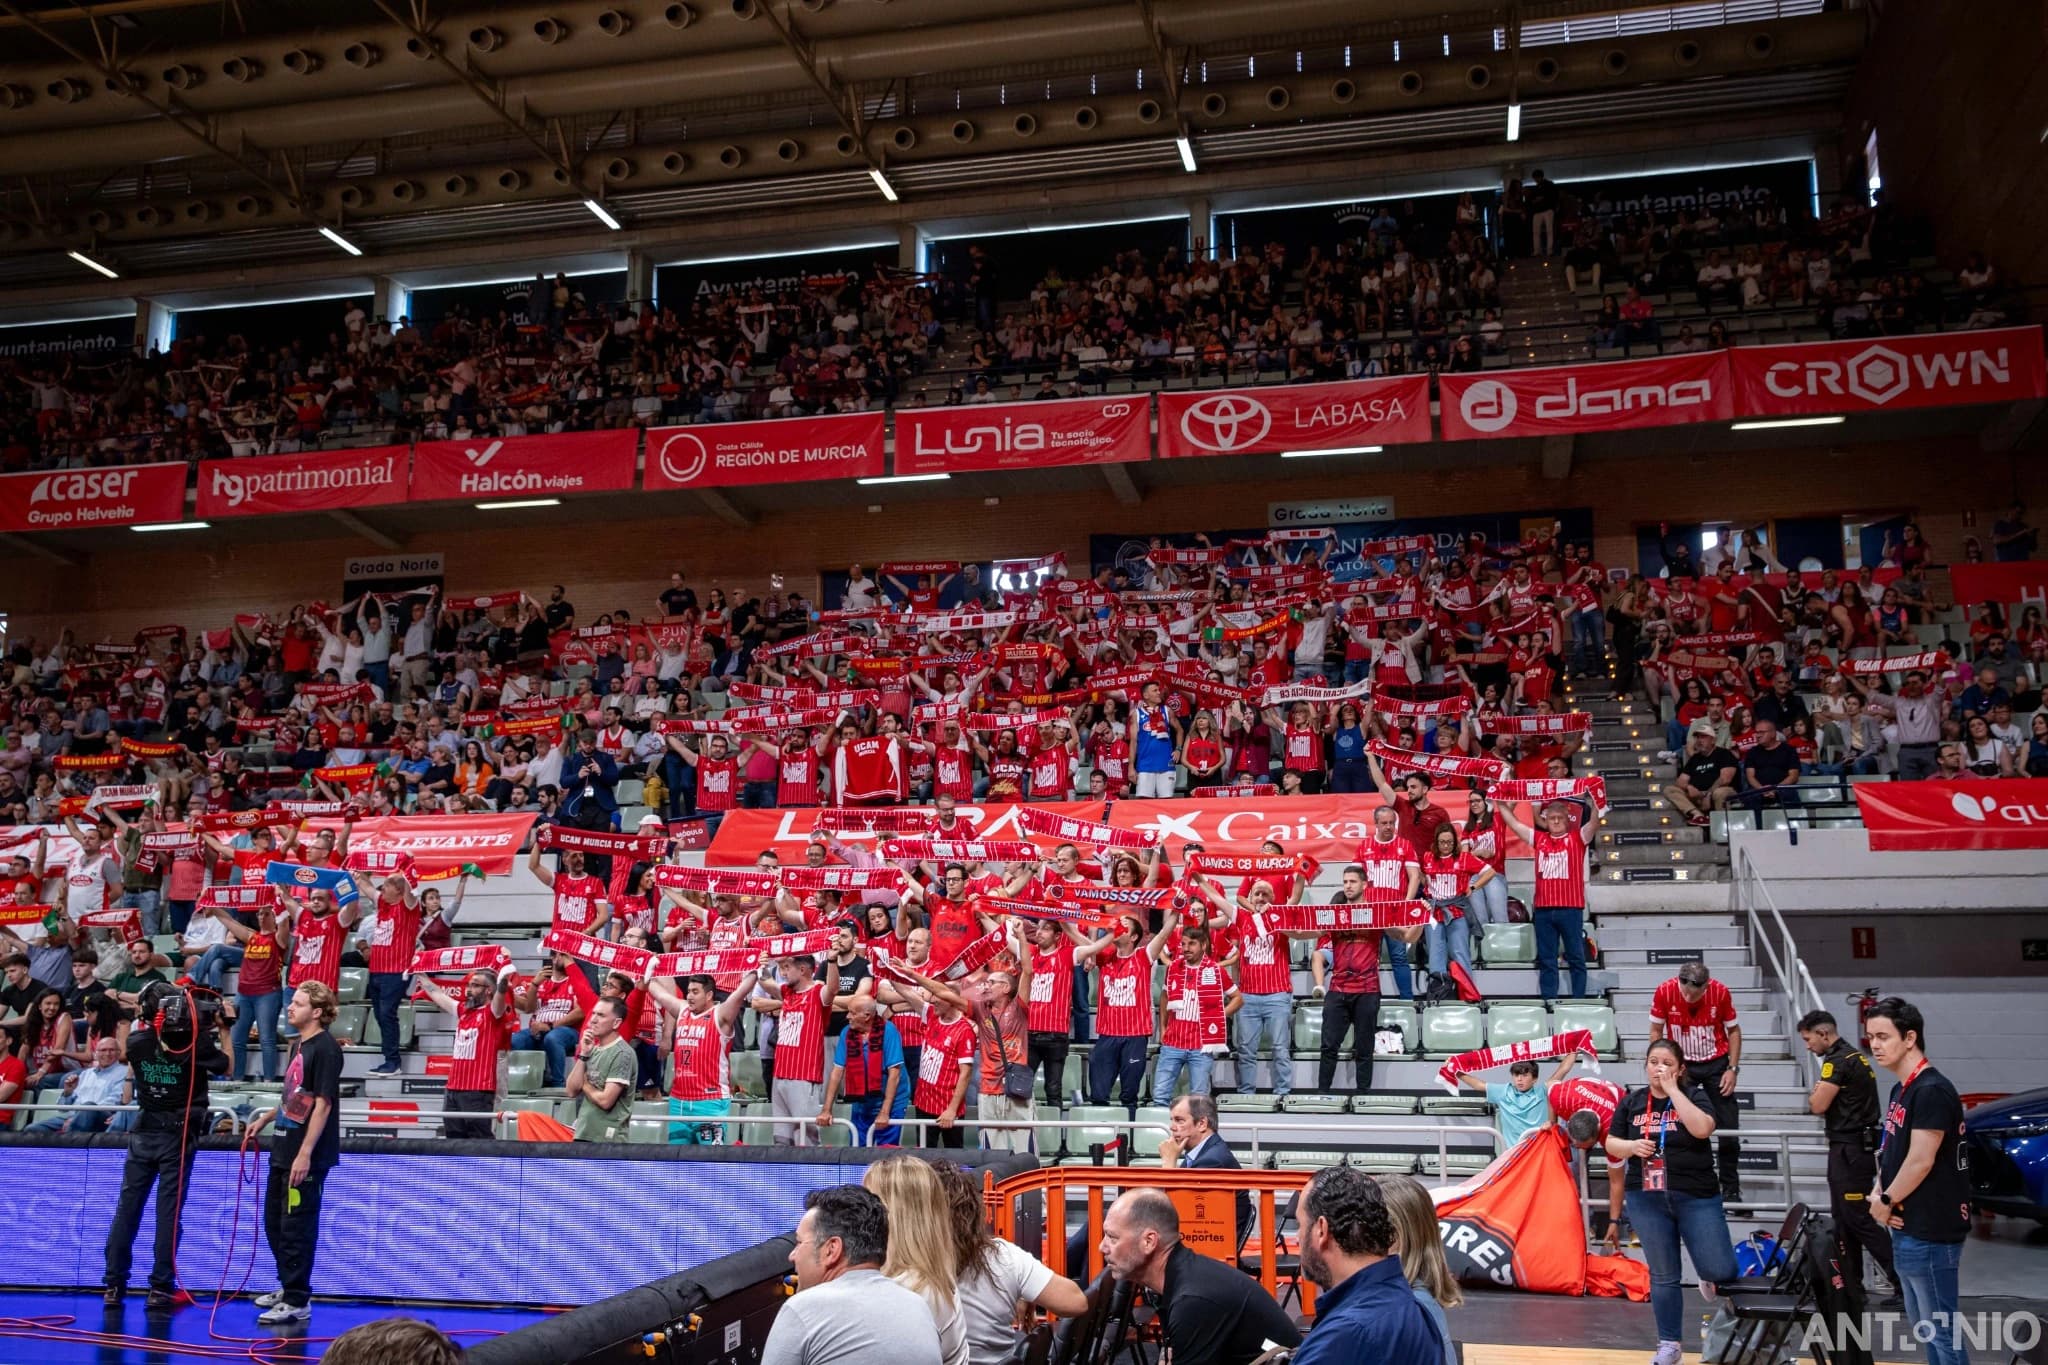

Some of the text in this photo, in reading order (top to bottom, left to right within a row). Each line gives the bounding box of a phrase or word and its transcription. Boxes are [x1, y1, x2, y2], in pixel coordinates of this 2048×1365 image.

[1535, 377, 1711, 418] dama
[1294, 398, 1406, 429] LABASA
[915, 417, 1045, 456] Lunia
[715, 444, 867, 467] REGIÓN DE MURCIA
[52, 471, 138, 500] caser
[246, 457, 393, 500] patrimonial
[461, 468, 583, 493] Halcón viajes
[28, 505, 135, 526] Grupo Helvetia
[349, 557, 440, 575] Grada Norte
[854, 741, 879, 753] UCAM
[394, 833, 512, 850] LEVANTE
[583, 837, 612, 848] MURCIA
[1237, 857, 1252, 869] CB
[1255, 855, 1294, 869] MURCIA
[1074, 888, 1168, 906] VAMOSSS!!!
